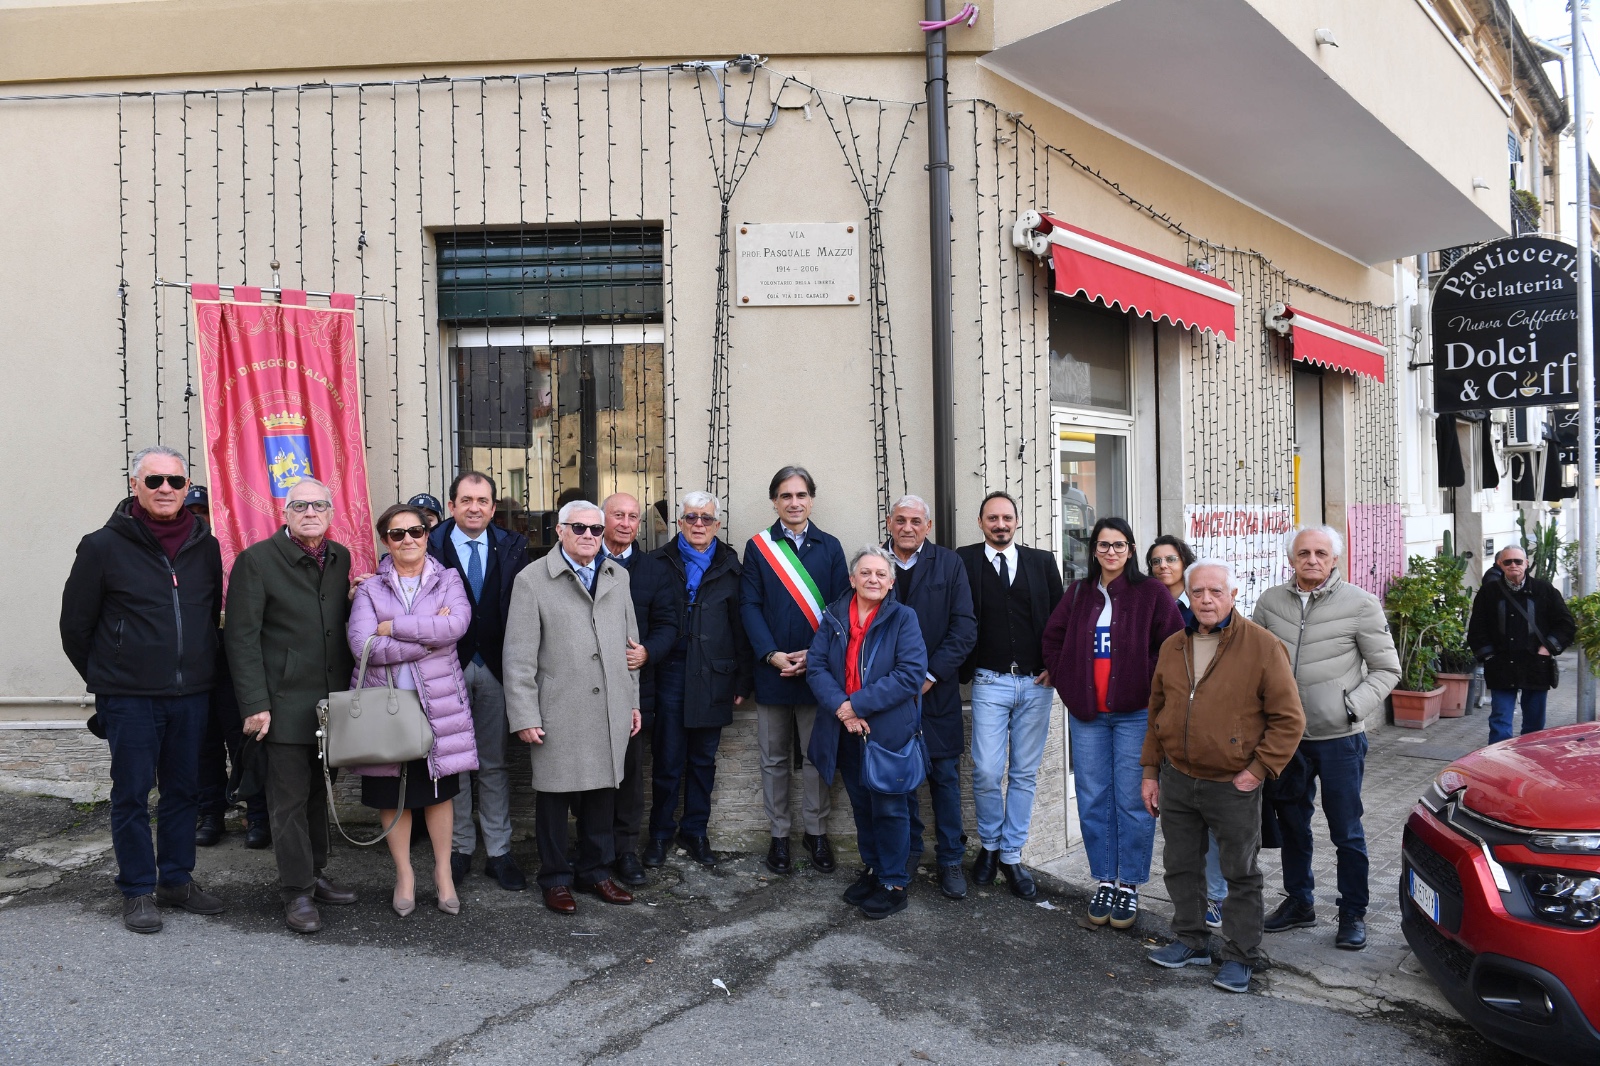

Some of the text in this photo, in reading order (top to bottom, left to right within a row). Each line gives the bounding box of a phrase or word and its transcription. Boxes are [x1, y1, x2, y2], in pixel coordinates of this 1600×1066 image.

[789, 231, 805, 239] VIA
[764, 247, 810, 258] PASQUALE
[776, 265, 791, 273] 1914
[800, 265, 819, 273] 2006
[1470, 273, 1563, 300] Gelateria
[1447, 308, 1578, 333] Nuova Caffetter
[1444, 333, 1539, 371] Dolci
[237, 364, 251, 377] DI
[251, 358, 297, 372] REGGIO
[300, 364, 345, 410] CALABRIA
[1459, 378, 1480, 402] &
[1190, 511, 1259, 539] MACELLERIA
